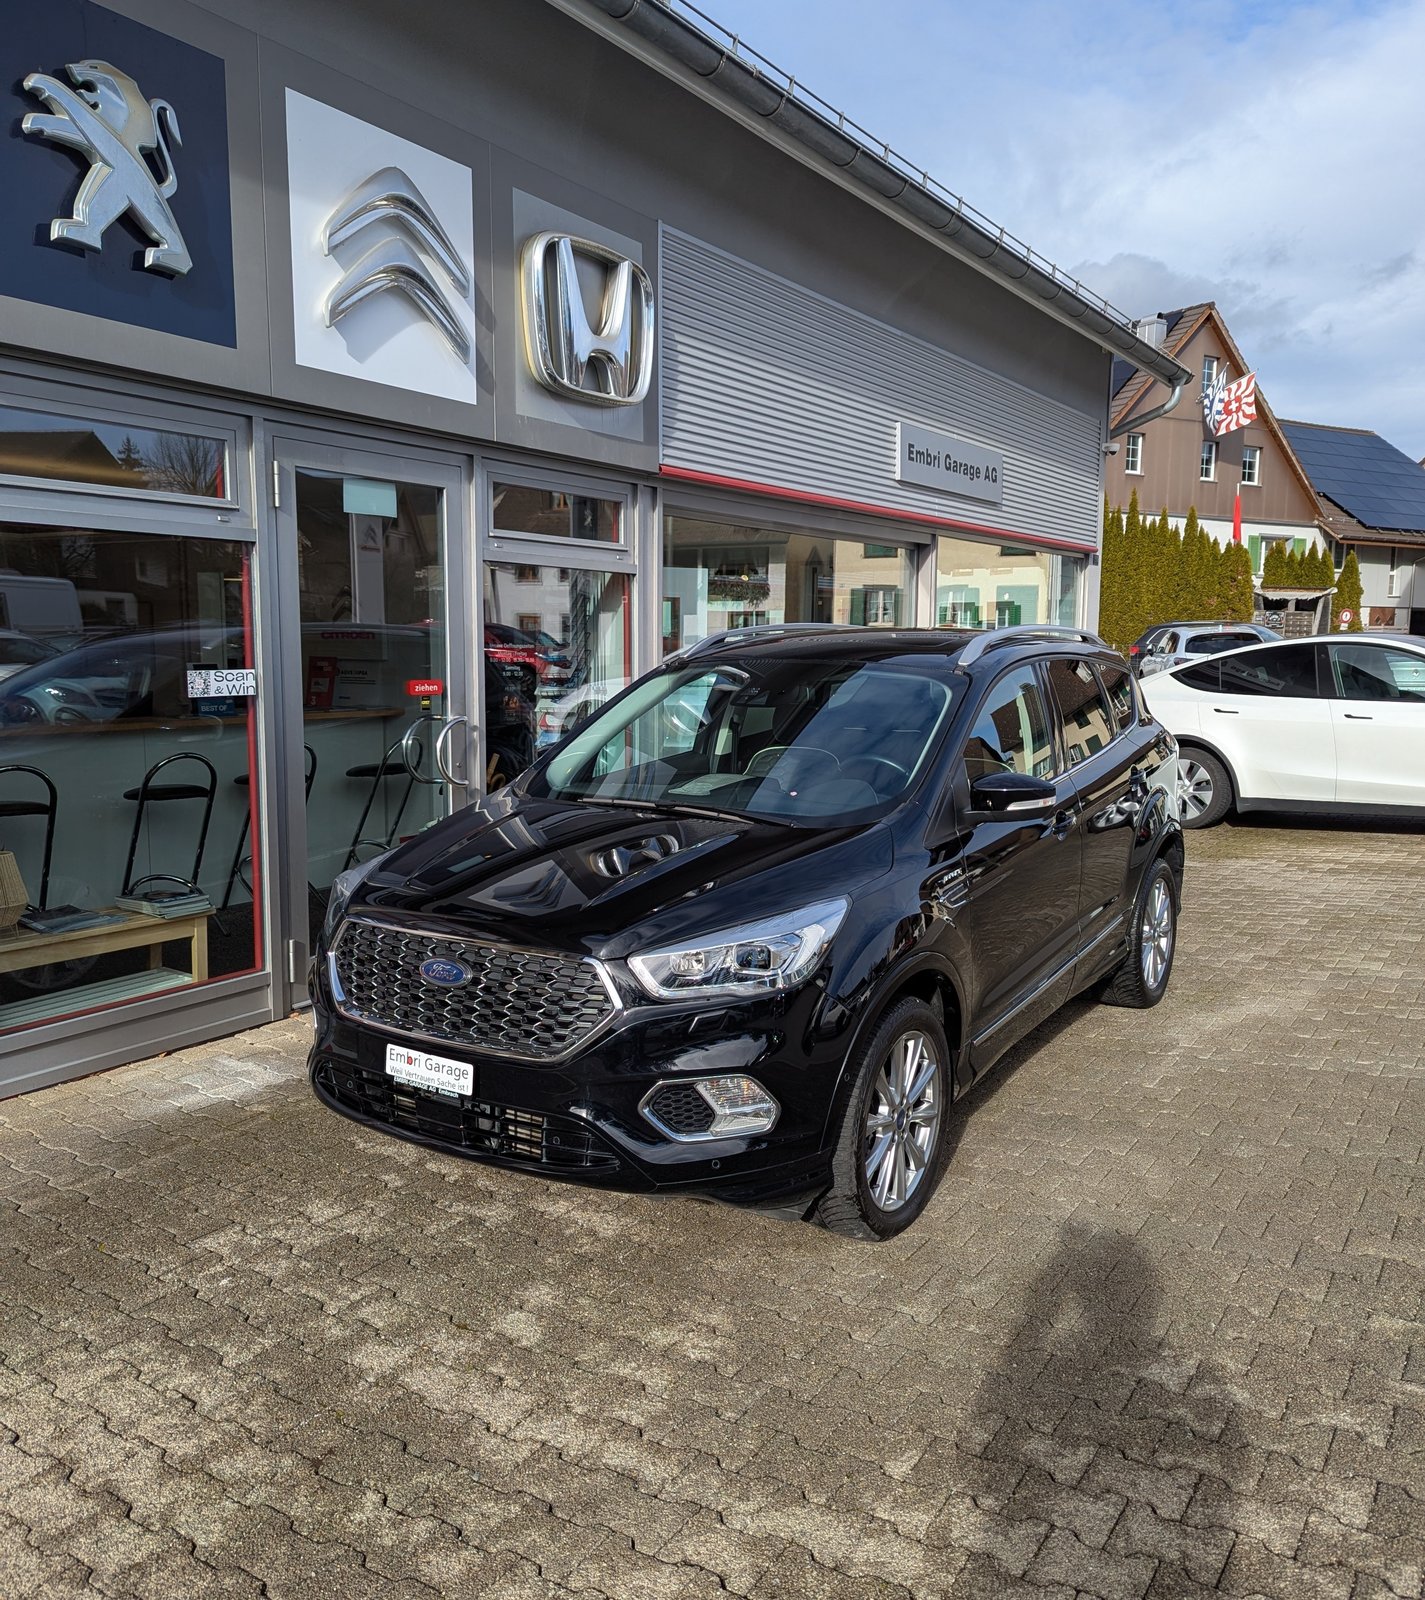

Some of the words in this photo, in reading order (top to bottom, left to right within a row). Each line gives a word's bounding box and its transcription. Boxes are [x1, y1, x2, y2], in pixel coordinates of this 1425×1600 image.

[907, 442, 941, 469] Embri
[944, 453, 981, 482] Garage
[984, 464, 998, 484] AG
[214, 671, 255, 682] Scan
[214, 685, 224, 695] &
[226, 682, 256, 695] Win
[414, 683, 438, 692] ziehen
[428, 962, 457, 980] Ford
[389, 1048, 421, 1068] Embri
[425, 1057, 469, 1081] Garage
[389, 1065, 403, 1075] Weil
[404, 1069, 436, 1085] Vertrauen
[437, 1078, 456, 1089] Sache
[457, 1084, 465, 1092] ist
[438, 1088, 459, 1098] Embrach
